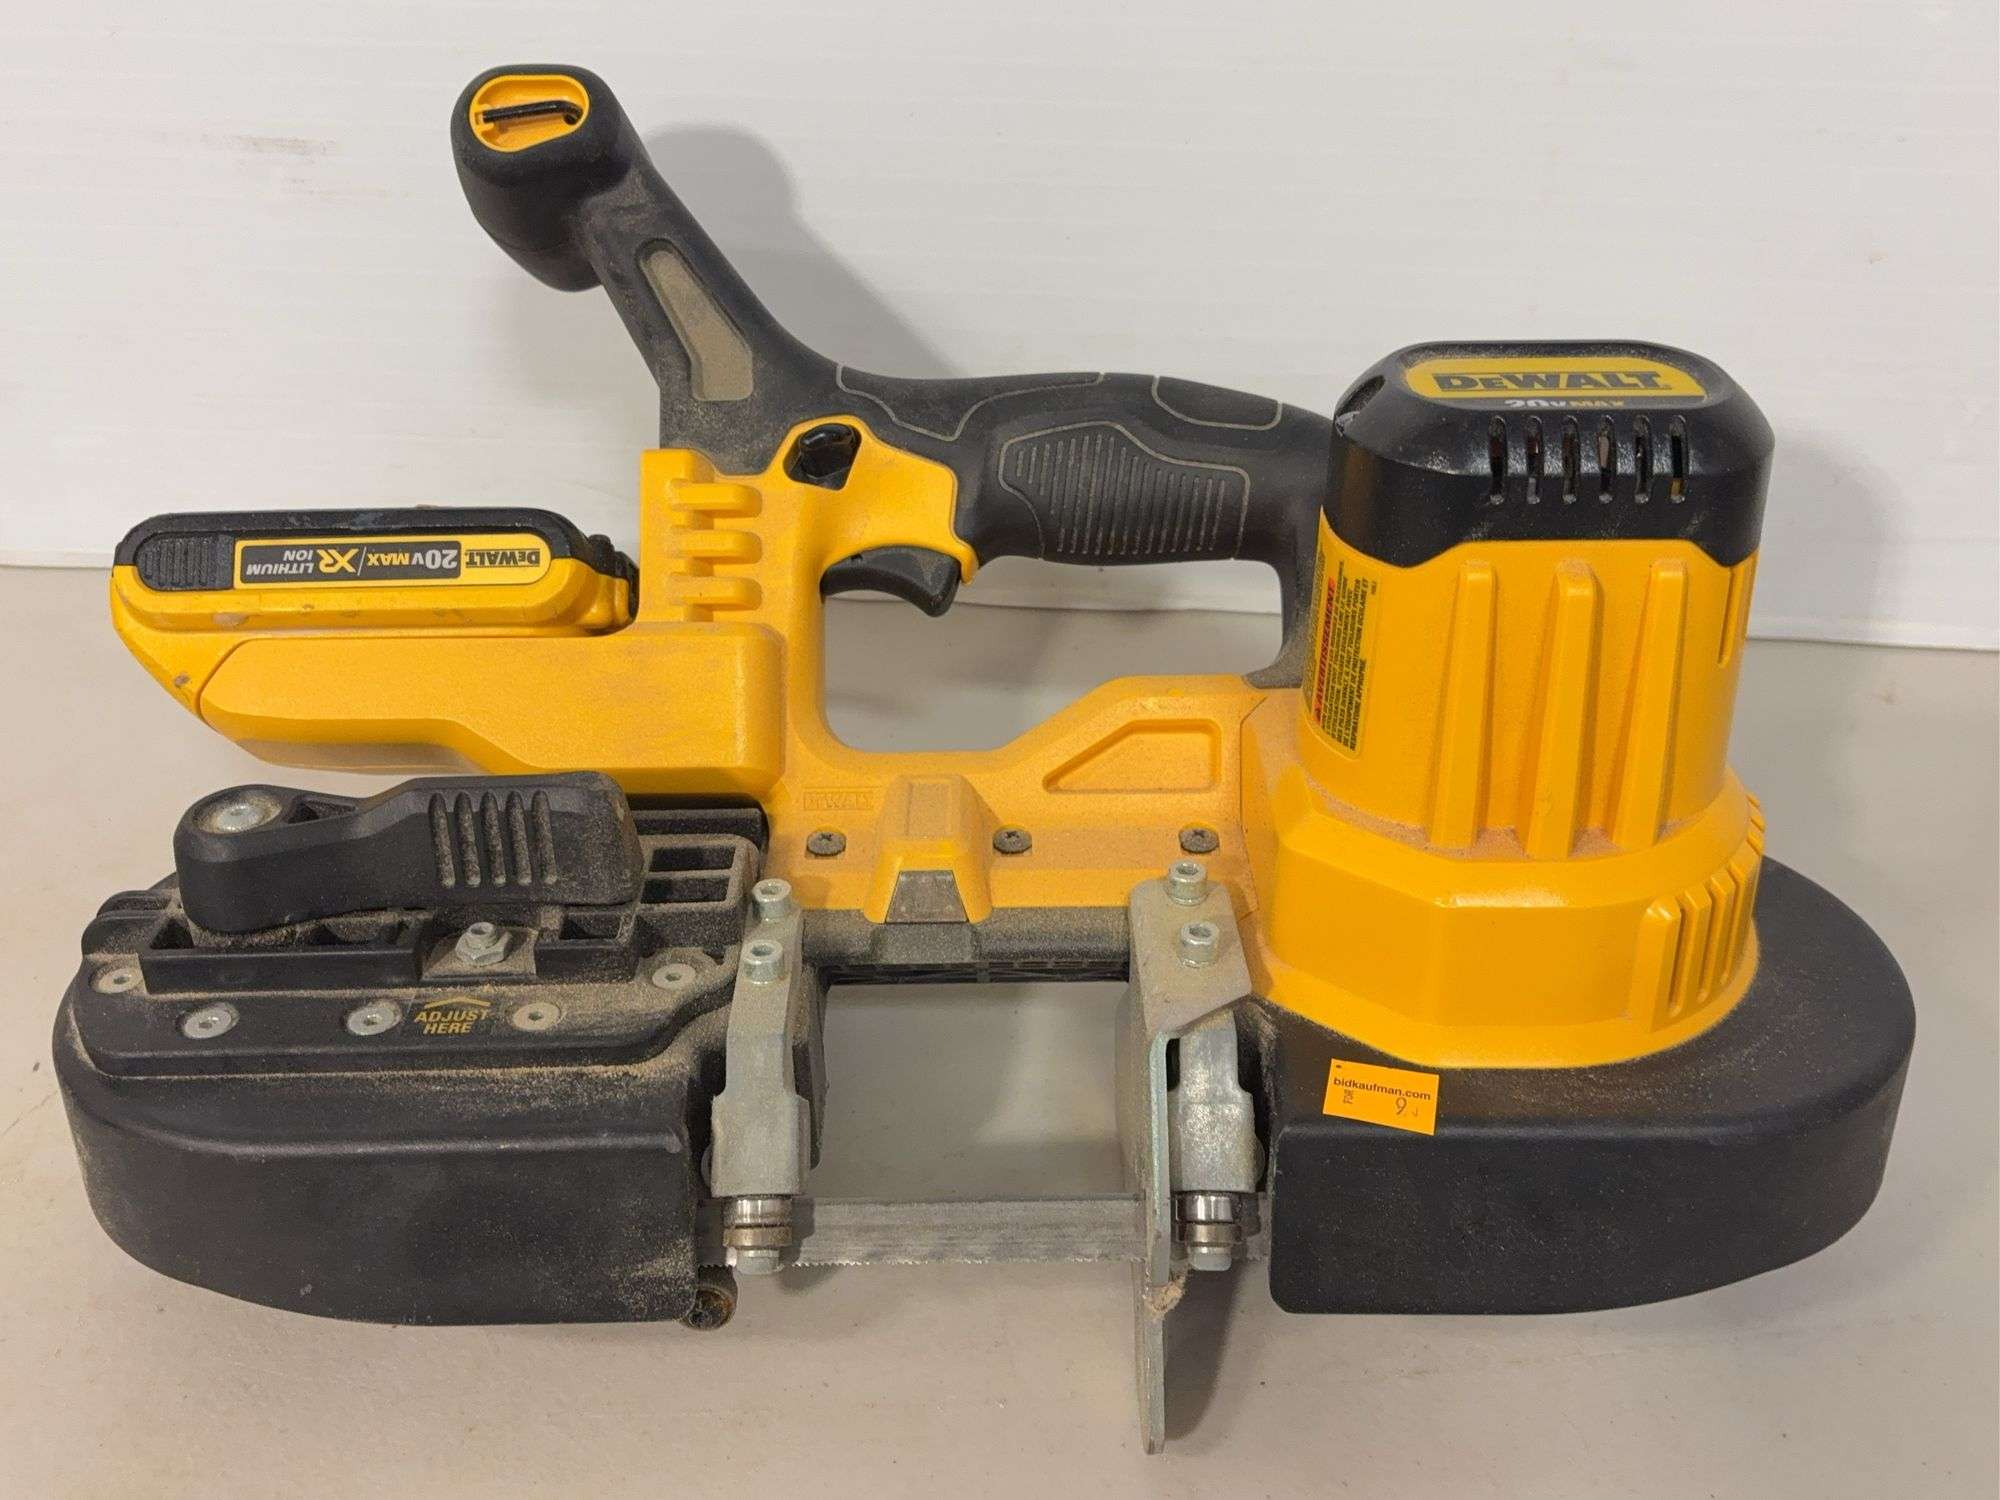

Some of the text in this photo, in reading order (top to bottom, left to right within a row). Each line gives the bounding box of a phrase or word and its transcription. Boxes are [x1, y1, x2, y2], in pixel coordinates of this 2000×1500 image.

[283, 550, 313, 562] ION
[316, 549, 359, 573] XR
[367, 552, 409, 567] MAX
[246, 562, 314, 576] LITHIUM
[1315, 586, 1334, 704] AVERTISSEMENT
[415, 1009, 489, 1022] ADJUST
[422, 1022, 472, 1034] HERE
[1333, 1078, 1431, 1100] bidkaufman.com
